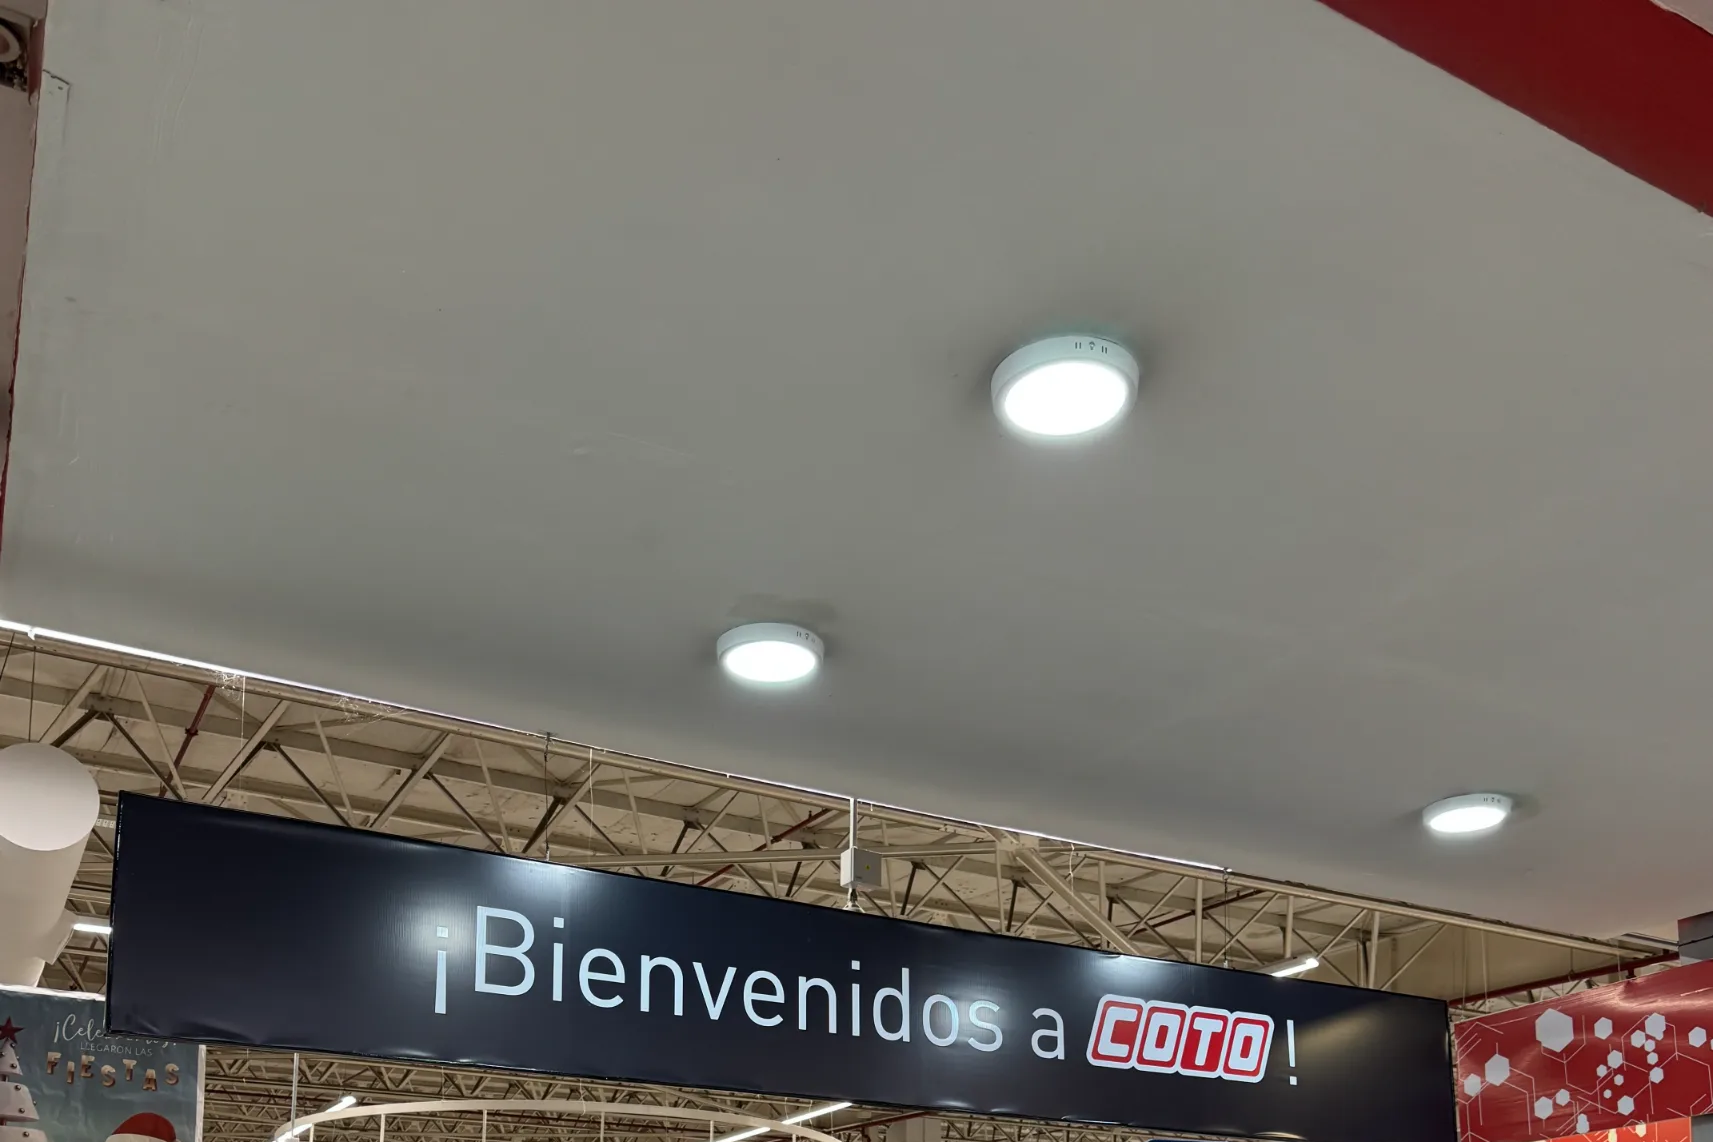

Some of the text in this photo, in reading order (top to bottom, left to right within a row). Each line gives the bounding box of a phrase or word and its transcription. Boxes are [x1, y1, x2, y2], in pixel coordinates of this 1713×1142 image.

[434, 905, 1004, 1053] ¡Bienvenidos
[1031, 1007, 1066, 1061] a
[80, 1041, 153, 1057] LLEGARON LAS
[46, 1051, 180, 1092] FIESTAS
